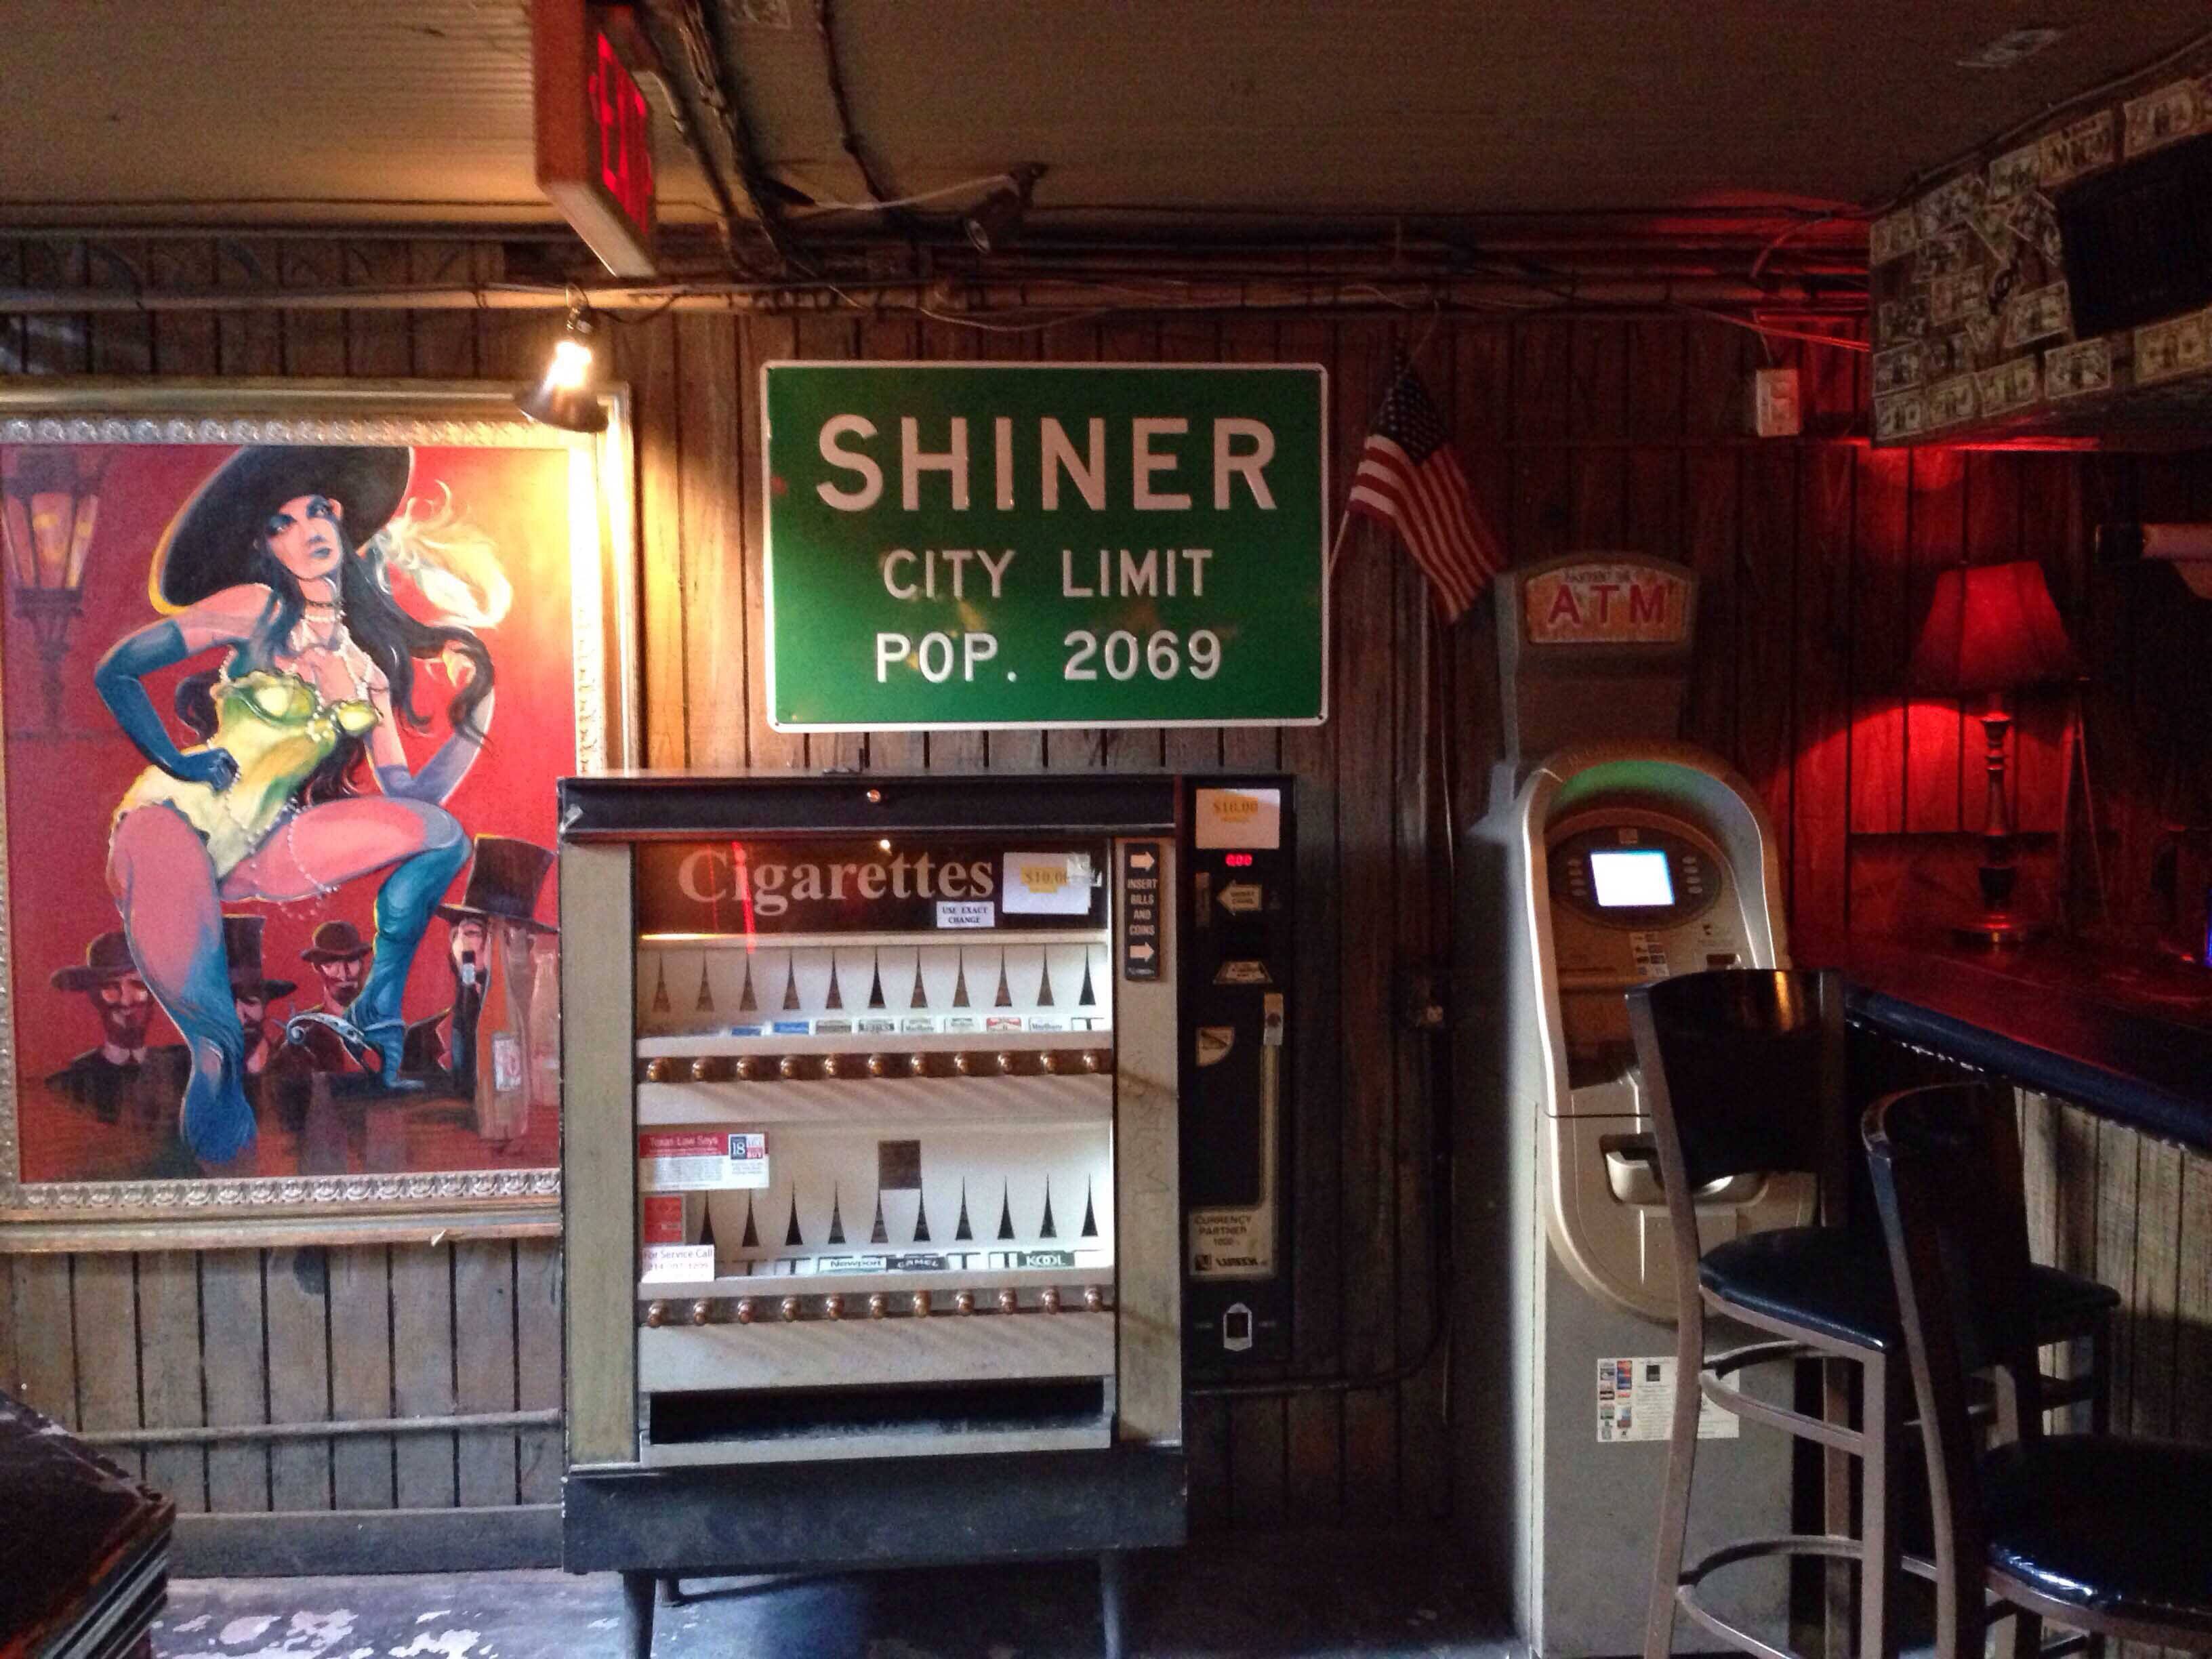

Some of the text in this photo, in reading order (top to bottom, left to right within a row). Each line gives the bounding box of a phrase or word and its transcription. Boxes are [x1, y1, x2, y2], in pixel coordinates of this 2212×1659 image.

[815, 413, 1277, 512] SHINER
[882, 548, 1213, 600] CITY LIMIT
[1547, 583, 1666, 625] ATM
[875, 629, 1221, 683] POP. 2069
[678, 842, 994, 916] Cigarettes
[1127, 878, 1158, 890] INSERT
[1130, 894, 1155, 905] BILLS
[948, 916, 981, 924] CHANGE
[1133, 909, 1151, 920] AND
[1129, 924, 1155, 936] COINS
[733, 1141, 745, 1155] 18
[661, 1249, 693, 1258] Service
[696, 1248, 713, 1258] Call
[830, 1260, 882, 1269] Newport
[897, 1258, 939, 1267] CAMEL
[1025, 1254, 1067, 1267] KOOL
